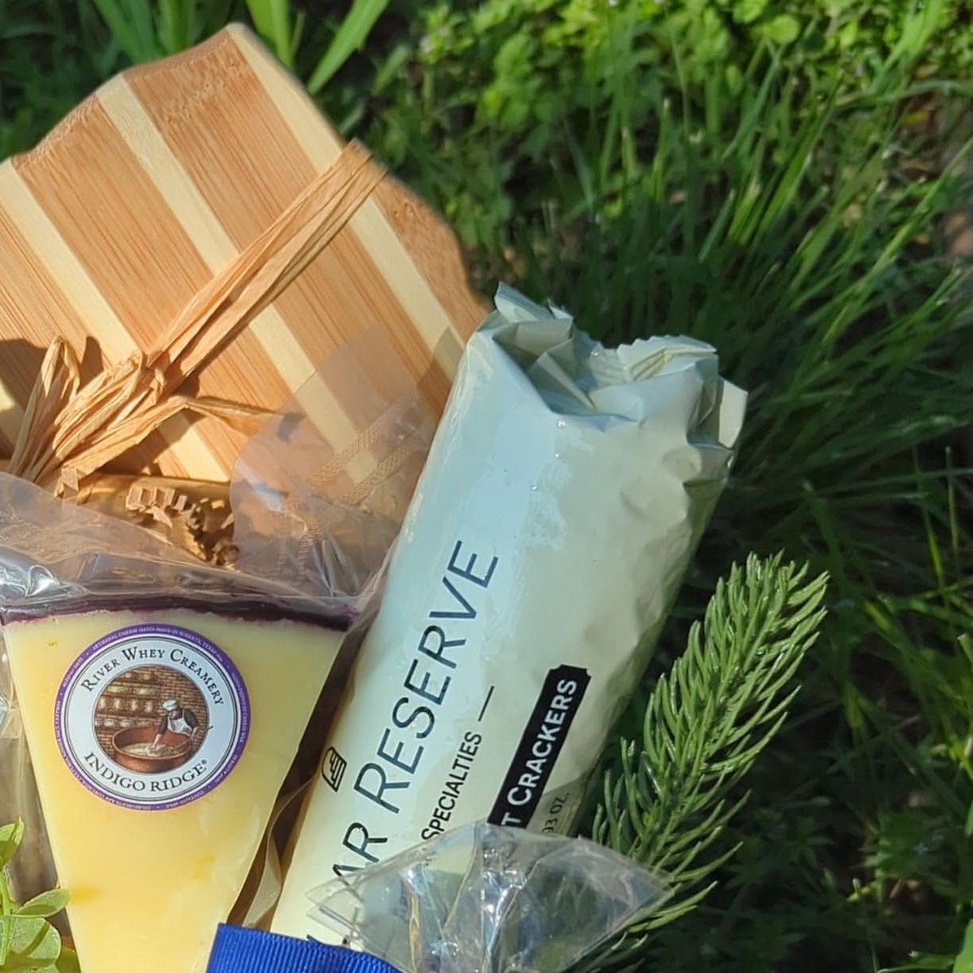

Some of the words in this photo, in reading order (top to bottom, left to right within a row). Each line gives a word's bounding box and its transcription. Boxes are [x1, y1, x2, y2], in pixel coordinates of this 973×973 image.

[81, 659, 121, 692] RIVER
[121, 646, 165, 661] WHEY
[170, 648, 223, 705] CREAMERY
[353, 540, 499, 813] RESERVE
[84, 752, 146, 792] INDIGO
[421, 731, 483, 841] SPECIALTIES
[506, 678, 577, 806] CRACKERS
